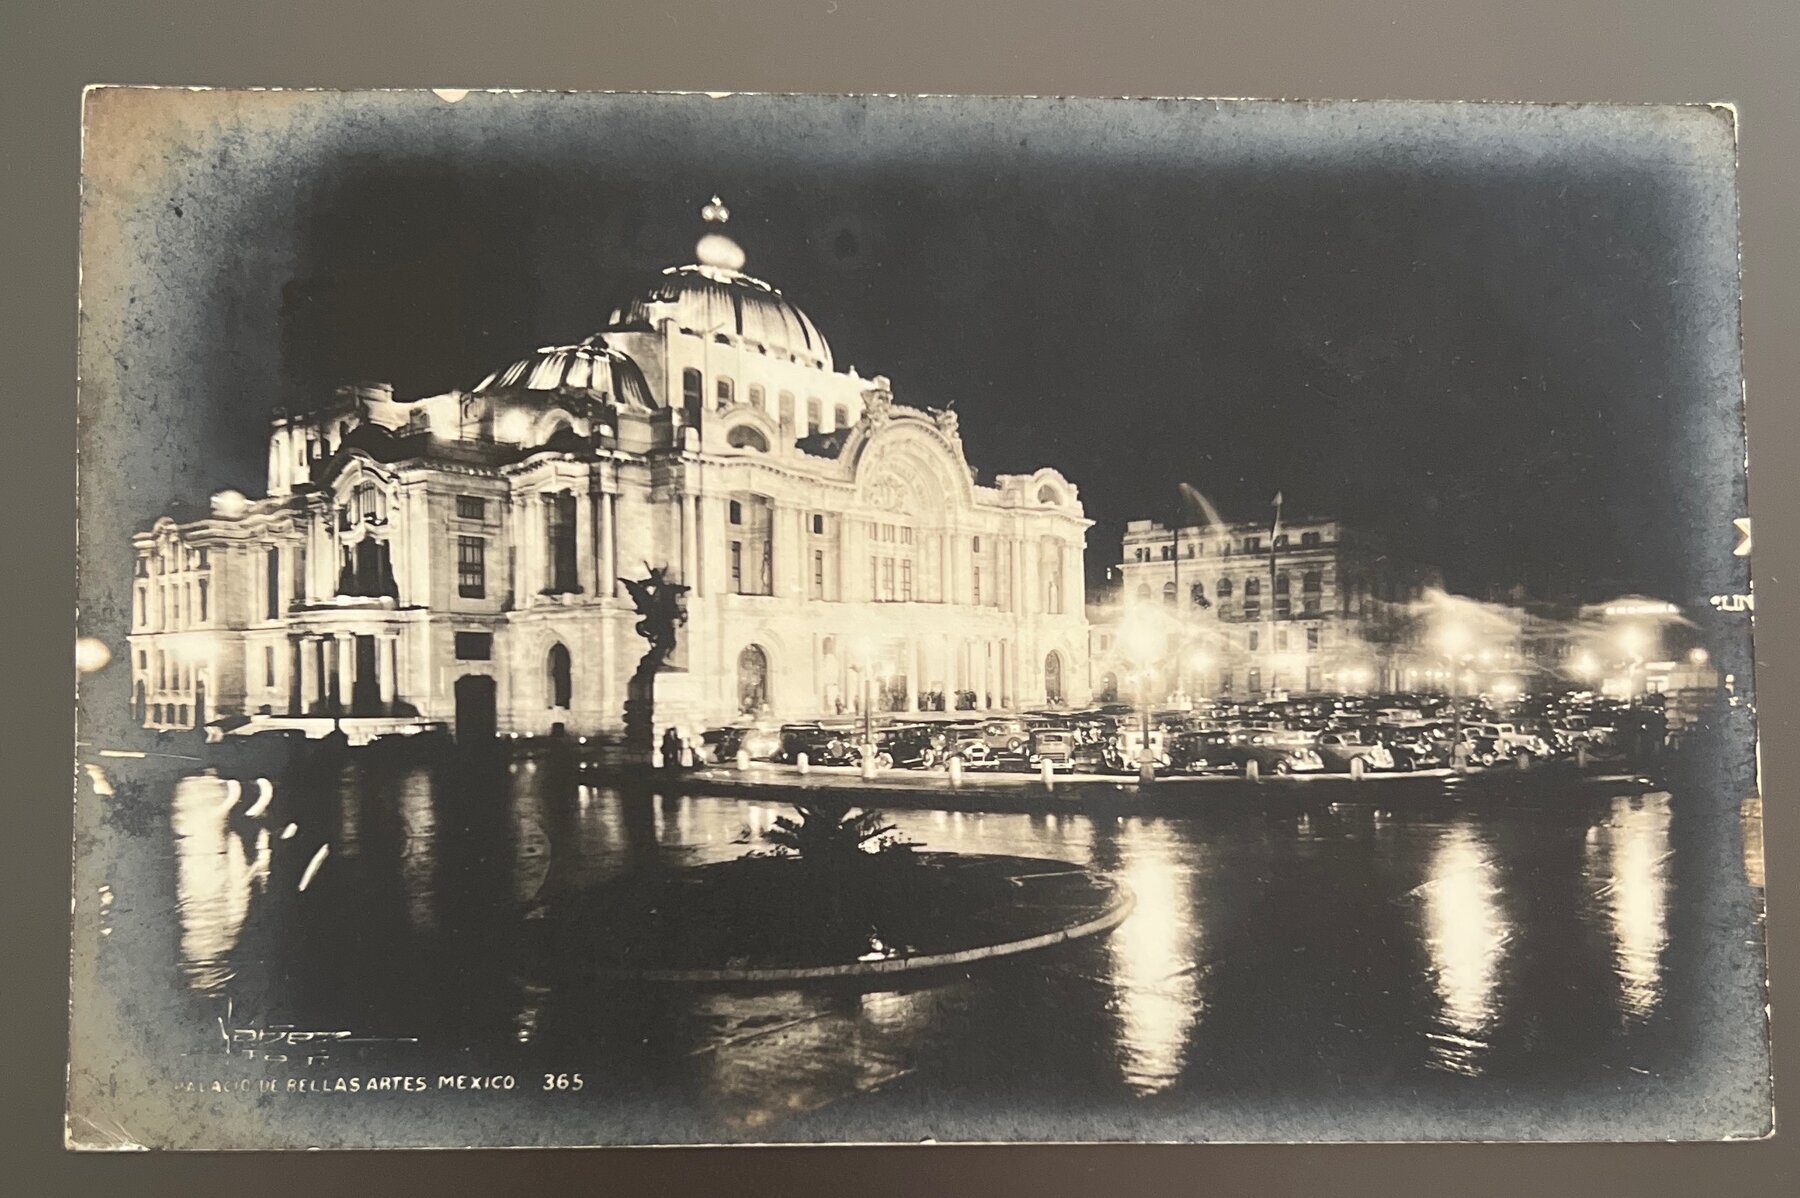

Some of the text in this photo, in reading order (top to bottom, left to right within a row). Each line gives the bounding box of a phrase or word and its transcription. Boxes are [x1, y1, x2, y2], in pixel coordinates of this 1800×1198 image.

[259, 1078, 278, 1094] DE
[286, 1077, 361, 1094] BELLAS
[366, 1076, 428, 1092] ARTES
[438, 1074, 516, 1091] MEXICO
[542, 1073, 585, 1092] 365
